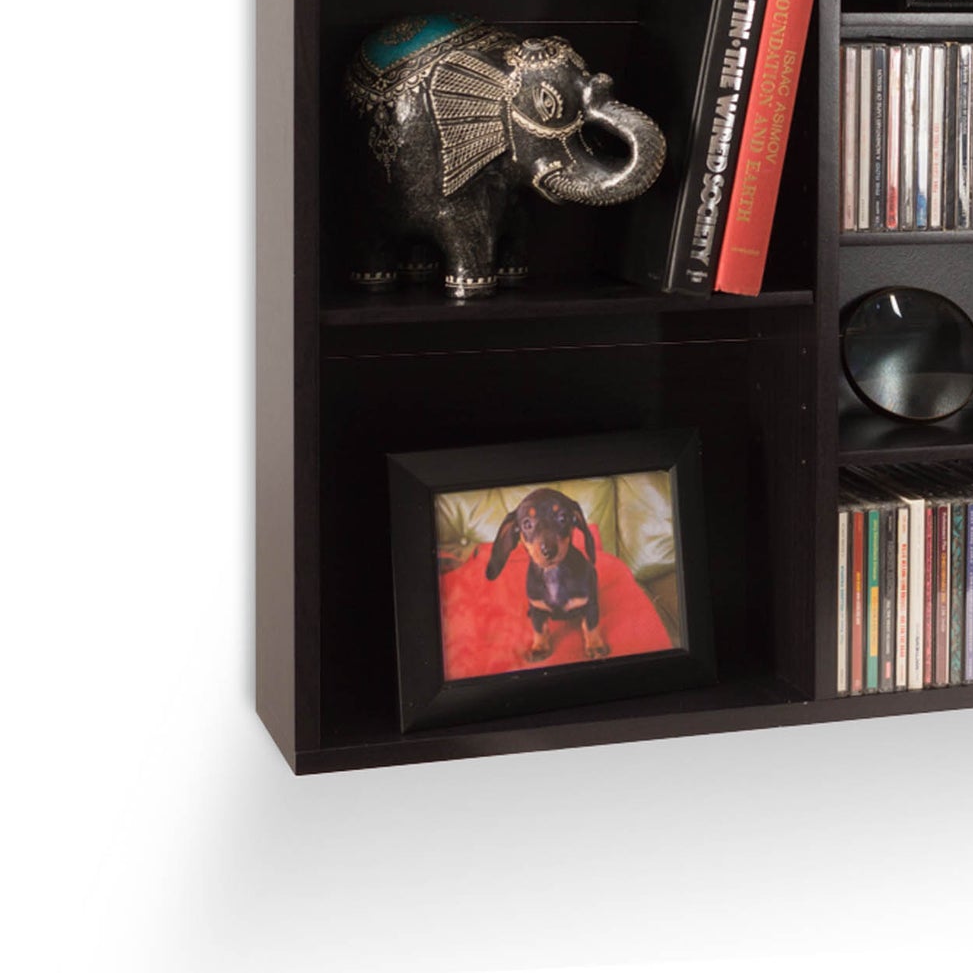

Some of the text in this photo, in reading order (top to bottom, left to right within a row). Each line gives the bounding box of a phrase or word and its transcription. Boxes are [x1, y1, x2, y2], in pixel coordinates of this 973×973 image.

[705, 93, 739, 176] WIRED
[750, 113, 769, 155] AND
[766, 49, 797, 166] ISAAC ASIMOV
[690, 173, 722, 265] SOCIETY
[735, 159, 760, 223] EARTH
